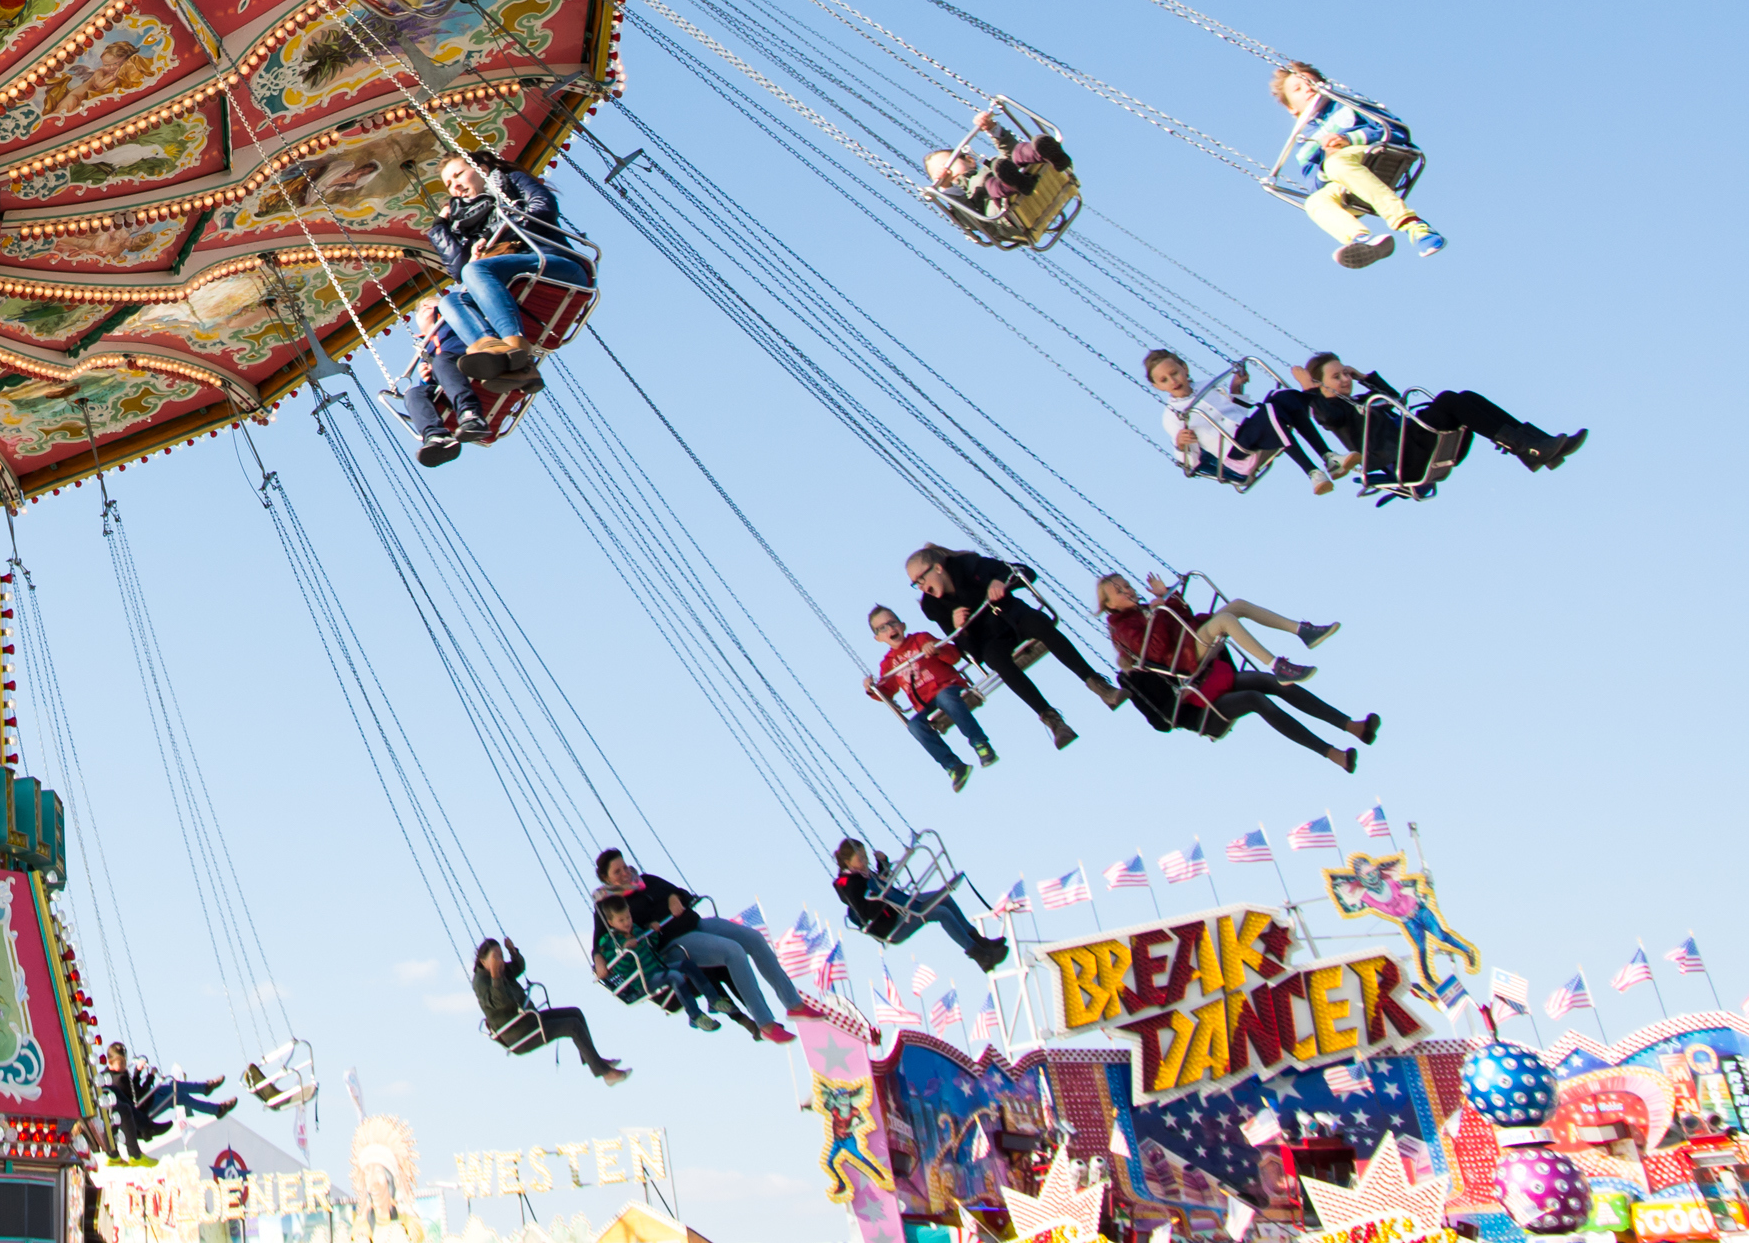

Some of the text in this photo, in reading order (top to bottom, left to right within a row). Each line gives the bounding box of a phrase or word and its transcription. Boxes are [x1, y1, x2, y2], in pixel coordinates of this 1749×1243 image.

[1046, 911, 1286, 1029] BREAK
[1118, 956, 1422, 1093] DANCER
[453, 1131, 667, 1199] WESTEN
